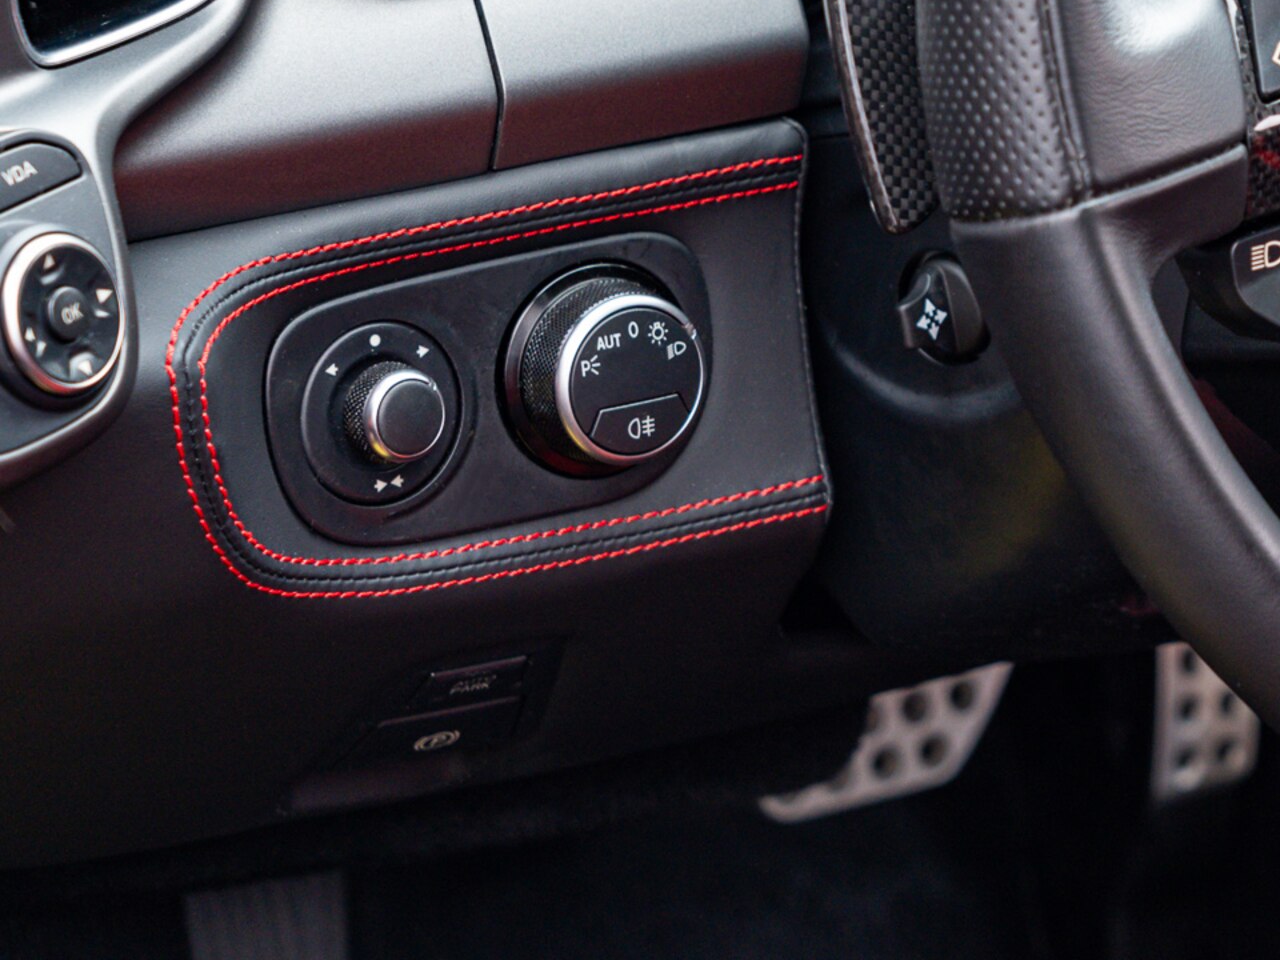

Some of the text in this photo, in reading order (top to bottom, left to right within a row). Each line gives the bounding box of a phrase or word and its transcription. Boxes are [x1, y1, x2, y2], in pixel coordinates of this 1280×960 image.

[1, 160, 39, 187] VDA
[61, 302, 85, 325] OK
[597, 332, 622, 351] AUT
